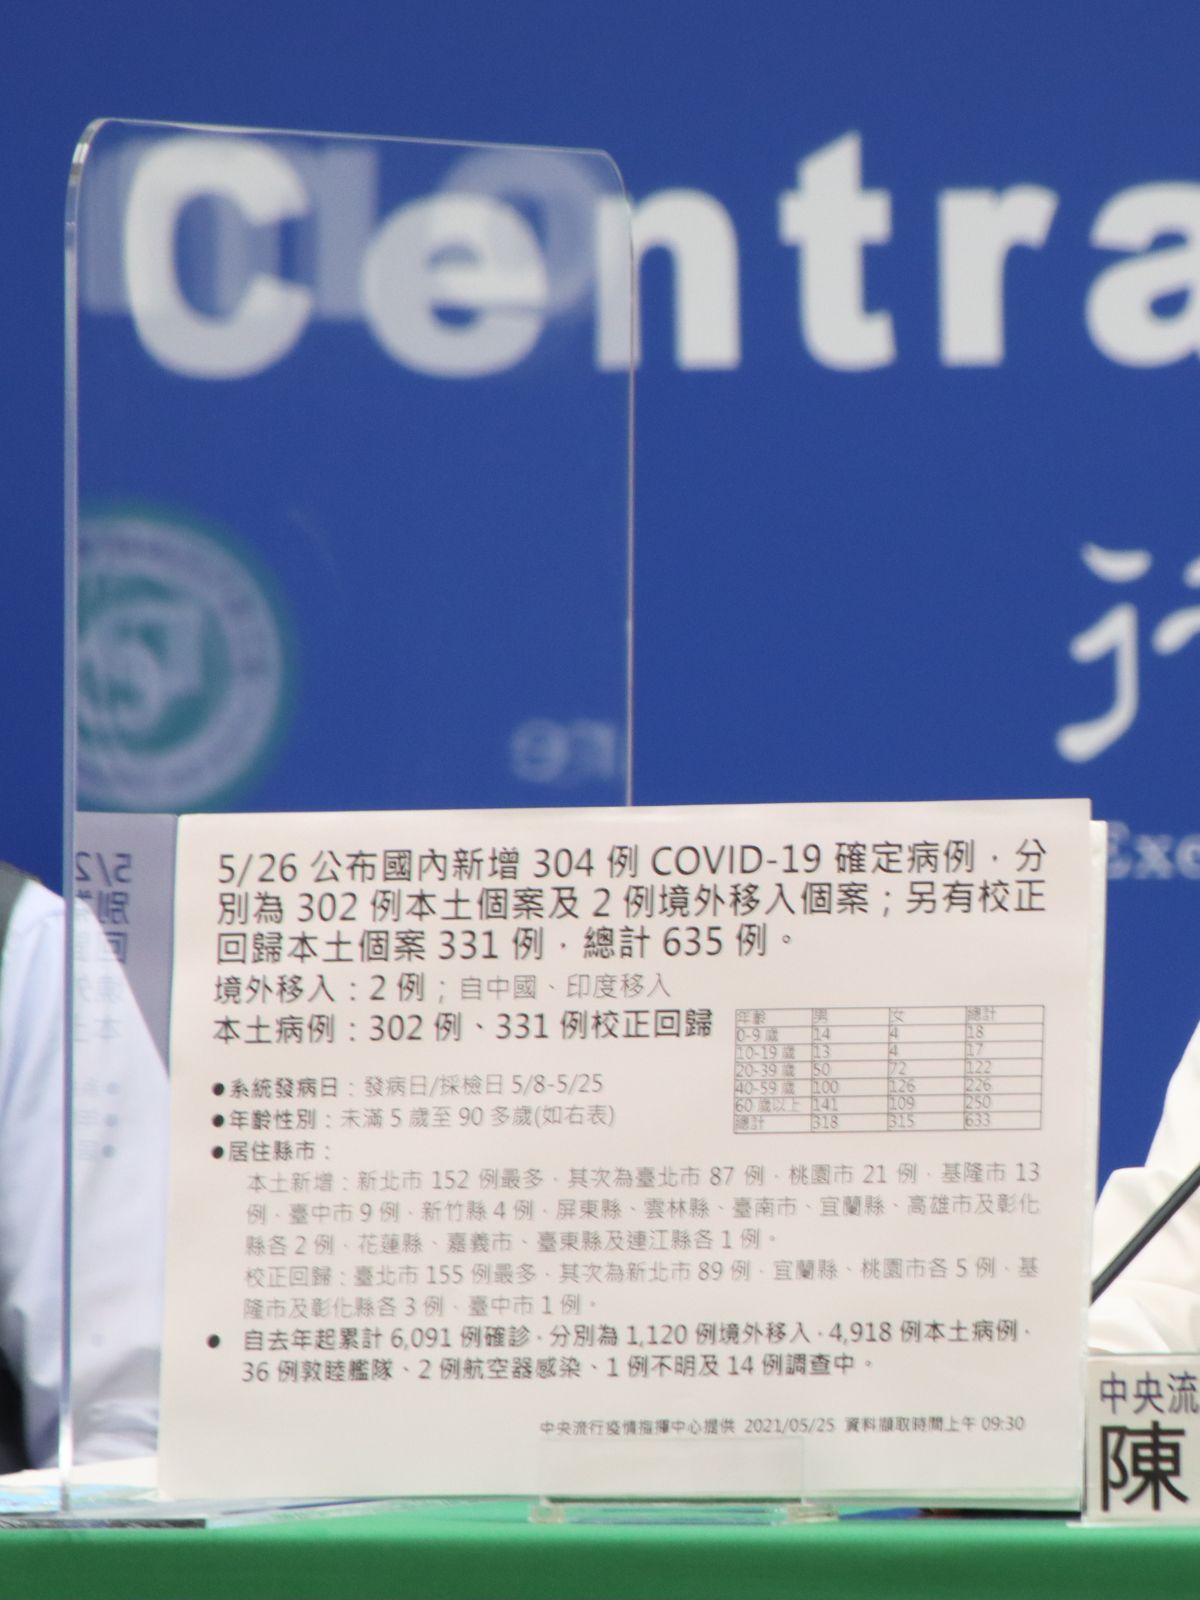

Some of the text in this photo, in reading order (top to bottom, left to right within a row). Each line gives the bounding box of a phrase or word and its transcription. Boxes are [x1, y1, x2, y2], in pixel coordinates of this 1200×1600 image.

[218, 852, 297, 886] 5/26
[311, 848, 519, 882] 公布國內新增
[534, 847, 594, 880] 304
[608, 846, 638, 880] 例
[651, 844, 821, 876] COVID-19
[217, 891, 283, 926] 別為
[297, 892, 357, 921] 302
[370, 887, 578, 922] 例本土個案及
[593, 888, 609, 916] 2
[216, 929, 425, 964] 回歸本土個案
[438, 930, 498, 960] 331
[663, 927, 722, 956] 635
[511, 1073, 604, 1097] 5/8-5/25
[390, 1107, 402, 1128] 5
[458, 1107, 484, 1128] 90
[432, 1170, 469, 1190] 152
[709, 1166, 735, 1186] 87
[862, 1165, 887, 1184] 21
[1015, 1162, 1041, 1182] 13
[359, 1202, 373, 1222] 9
[493, 1200, 505, 1219] 4
[294, 1236, 306, 1255] 2
[721, 1230, 732, 1249] 1
[426, 1264, 464, 1284] 155
[697, 1261, 724, 1281] 89
[955, 1258, 967, 1279] 5
[404, 1297, 416, 1316] 3
[542, 1296, 552, 1315] 1
[244, 1327, 383, 1351] 自去年起累計
[390, 1327, 452, 1351] 6,091
[626, 1323, 688, 1348] 1,120
[241, 1361, 269, 1382] 36
[728, 1355, 753, 1375] 14
[744, 1417, 835, 1436] 2021/05/25
[981, 1416, 1026, 1432] 09:30
